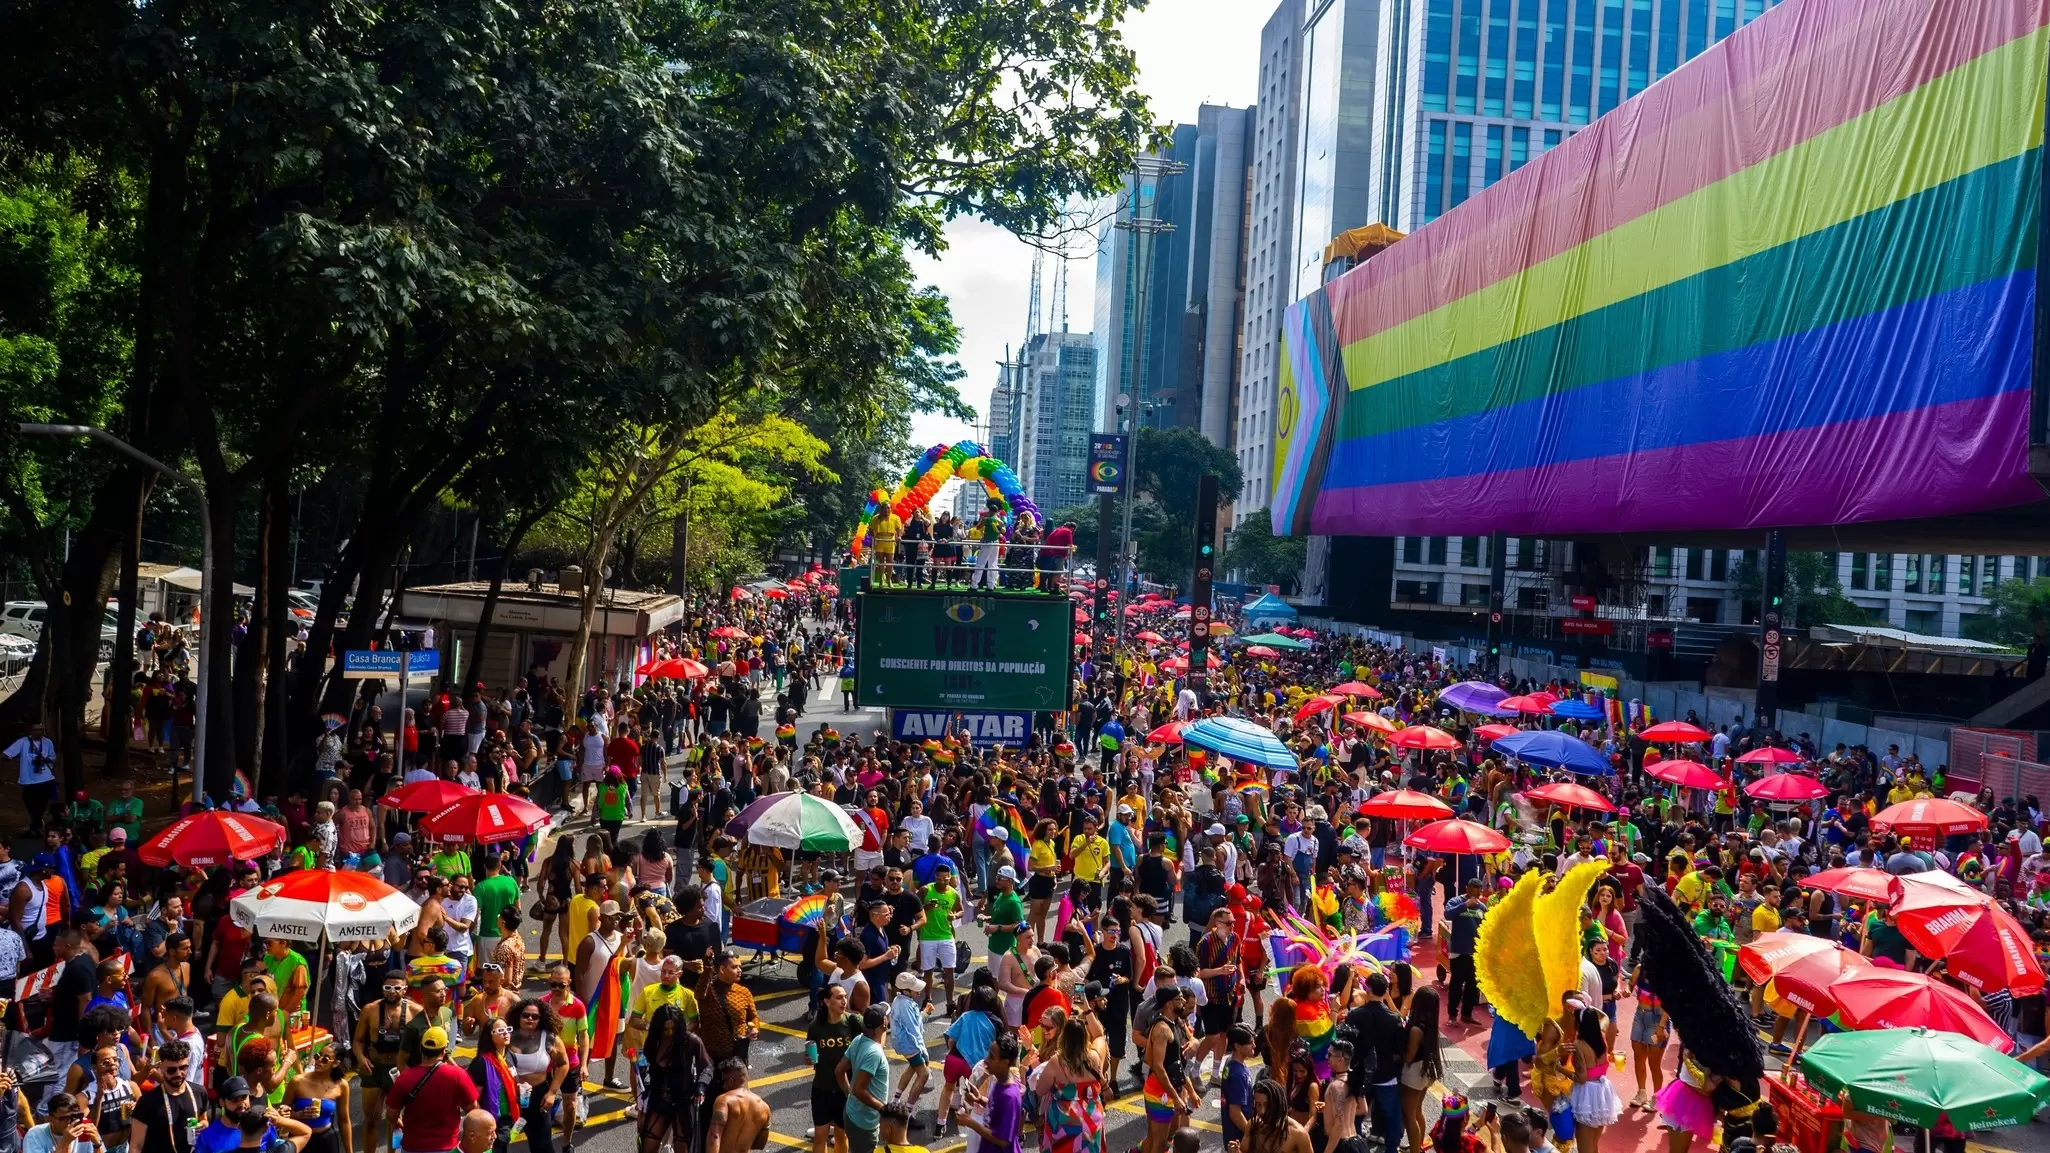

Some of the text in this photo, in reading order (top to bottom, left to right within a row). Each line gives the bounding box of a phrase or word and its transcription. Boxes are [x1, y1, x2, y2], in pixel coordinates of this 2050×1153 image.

[934, 625, 997, 659] VOTE
[349, 654, 400, 664] Casa Branca
[409, 653, 430, 663] Paulista
[880, 658, 1046, 675] CONSCIENTE POR DIREITOS DA POPULAÇÃO
[432, 803, 460, 822] BRAHMA
[157, 820, 194, 848] BRAHMA
[1949, 824, 1968, 832] BRAHMA
[444, 834, 464, 842] BRAHMA
[270, 923, 308, 936] AMSTEL
[1924, 908, 1971, 936] BRAHMA
[339, 926, 377, 936] AMSTEL
[2000, 928, 2027, 975] BRAHMA
[1958, 970, 1984, 988] BRAHMA
[1787, 992, 1815, 1012] BRAHMA
[820, 1036, 850, 1048] BOSS
[1867, 1105, 1919, 1125] Heineken
[1969, 1116, 2017, 1130] Heineken
